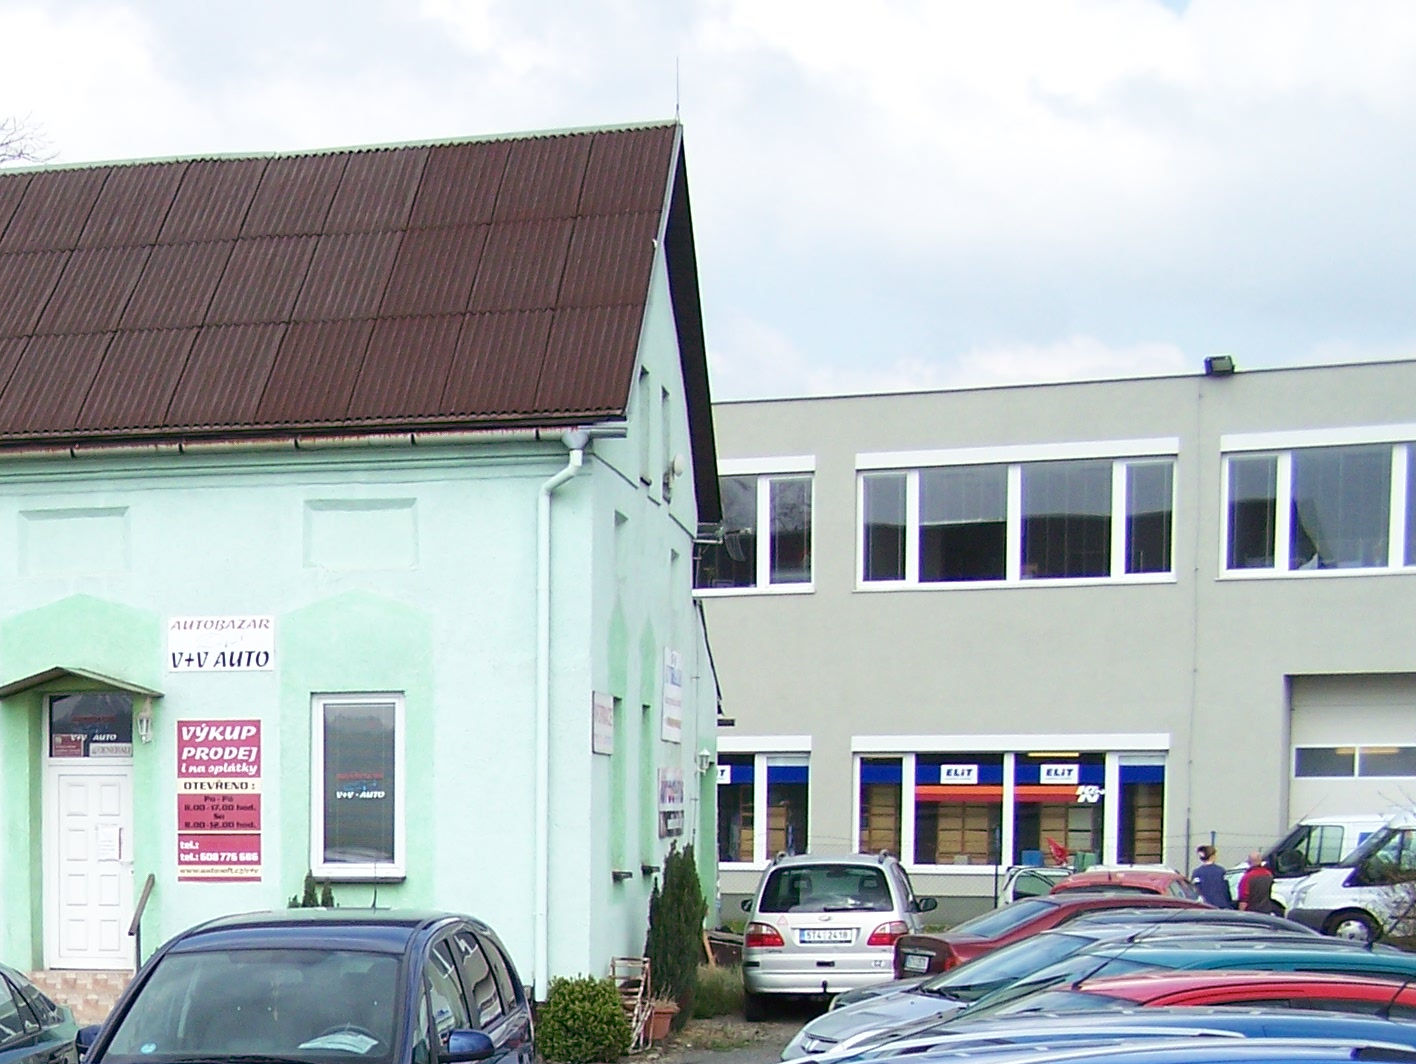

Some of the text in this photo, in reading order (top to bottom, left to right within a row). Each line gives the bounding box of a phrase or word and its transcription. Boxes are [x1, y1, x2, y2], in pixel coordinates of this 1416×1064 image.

[171, 619, 270, 631] AUTOBAZAR
[171, 650, 270, 668] V+V AUTO
[92, 733, 117, 741] AUTO
[181, 723, 257, 743] VÝKUP
[181, 746, 258, 762] PRODEJ
[181, 762, 187, 773] i
[188, 764, 206, 774] na
[183, 780, 249, 790] OTEVŘENO
[359, 791, 386, 799] AUTO
